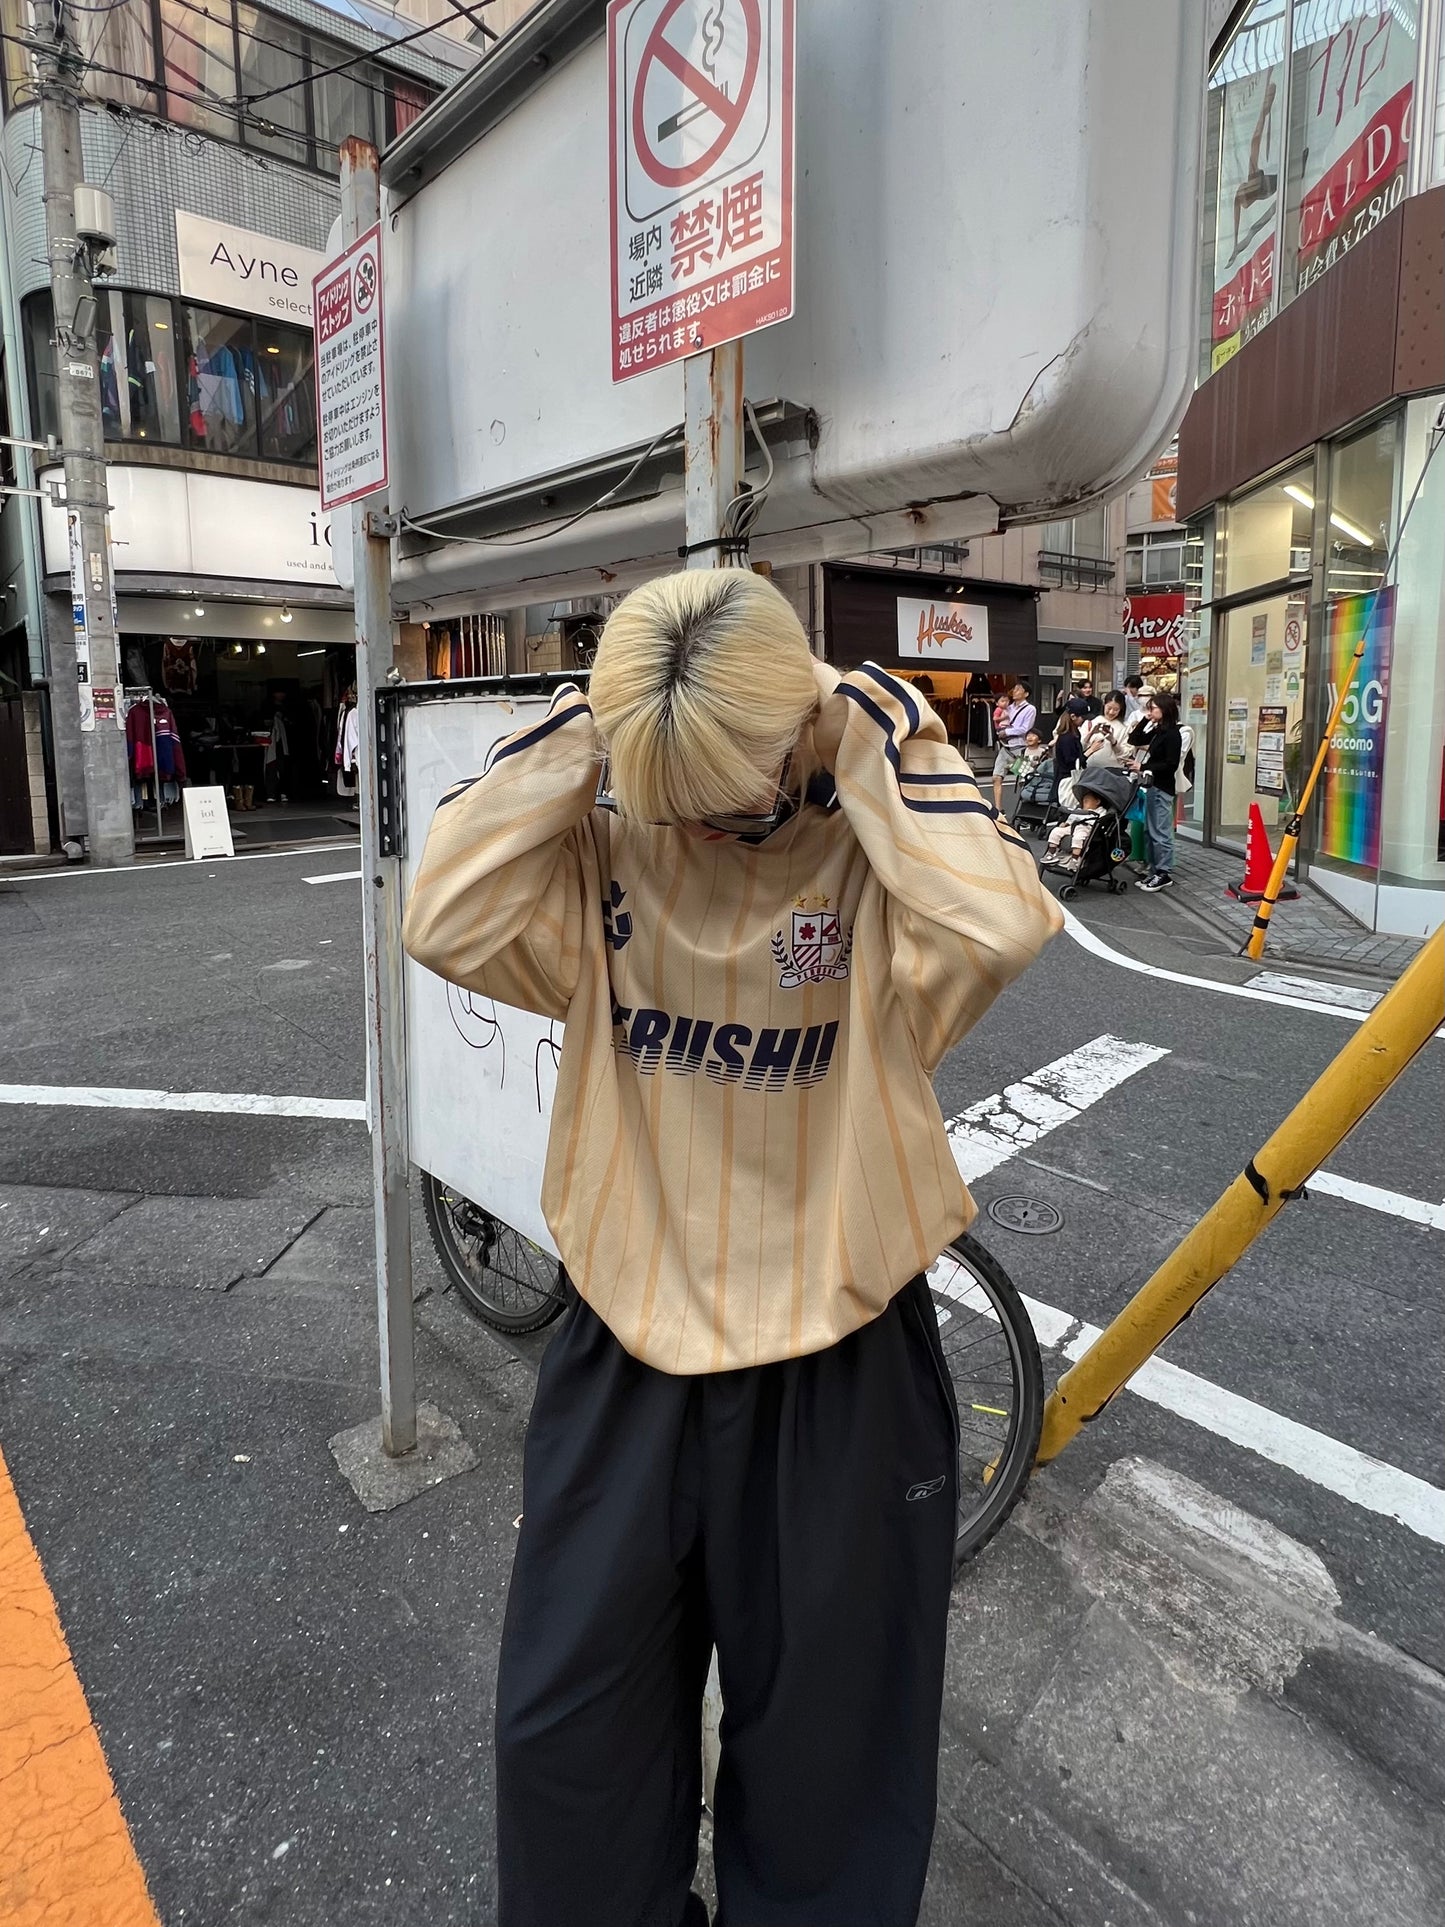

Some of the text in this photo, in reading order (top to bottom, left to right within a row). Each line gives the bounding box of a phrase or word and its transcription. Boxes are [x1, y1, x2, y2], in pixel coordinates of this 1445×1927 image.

[629, 224, 662, 261] 場内
[670, 169, 764, 281] 禁煙
[210, 242, 298, 287] Ayne
[629, 263, 663, 303] 近隣
[268, 296, 312, 316] select
[320, 274, 349, 316] アイドリング
[618, 257, 781, 346] 違反者は懲役又は罰金に
[321, 299, 350, 339] ストップ
[321, 338, 378, 385] のアイドリングを禁止さ
[321, 361, 376, 402] せていただいています。
[322, 384, 380, 427] 駐停車中はエンジンを
[323, 403, 380, 443] お切りいただけますよう
[324, 428, 373, 461] ご協力お願いします。
[286, 560, 307, 569] used
[310, 562, 326, 570] and
[917, 603, 973, 654] Huskies
[1122, 614, 1188, 639] ムセンタ
[1340, 679, 1383, 724] 5G
[1330, 734, 1373, 751] docomo
